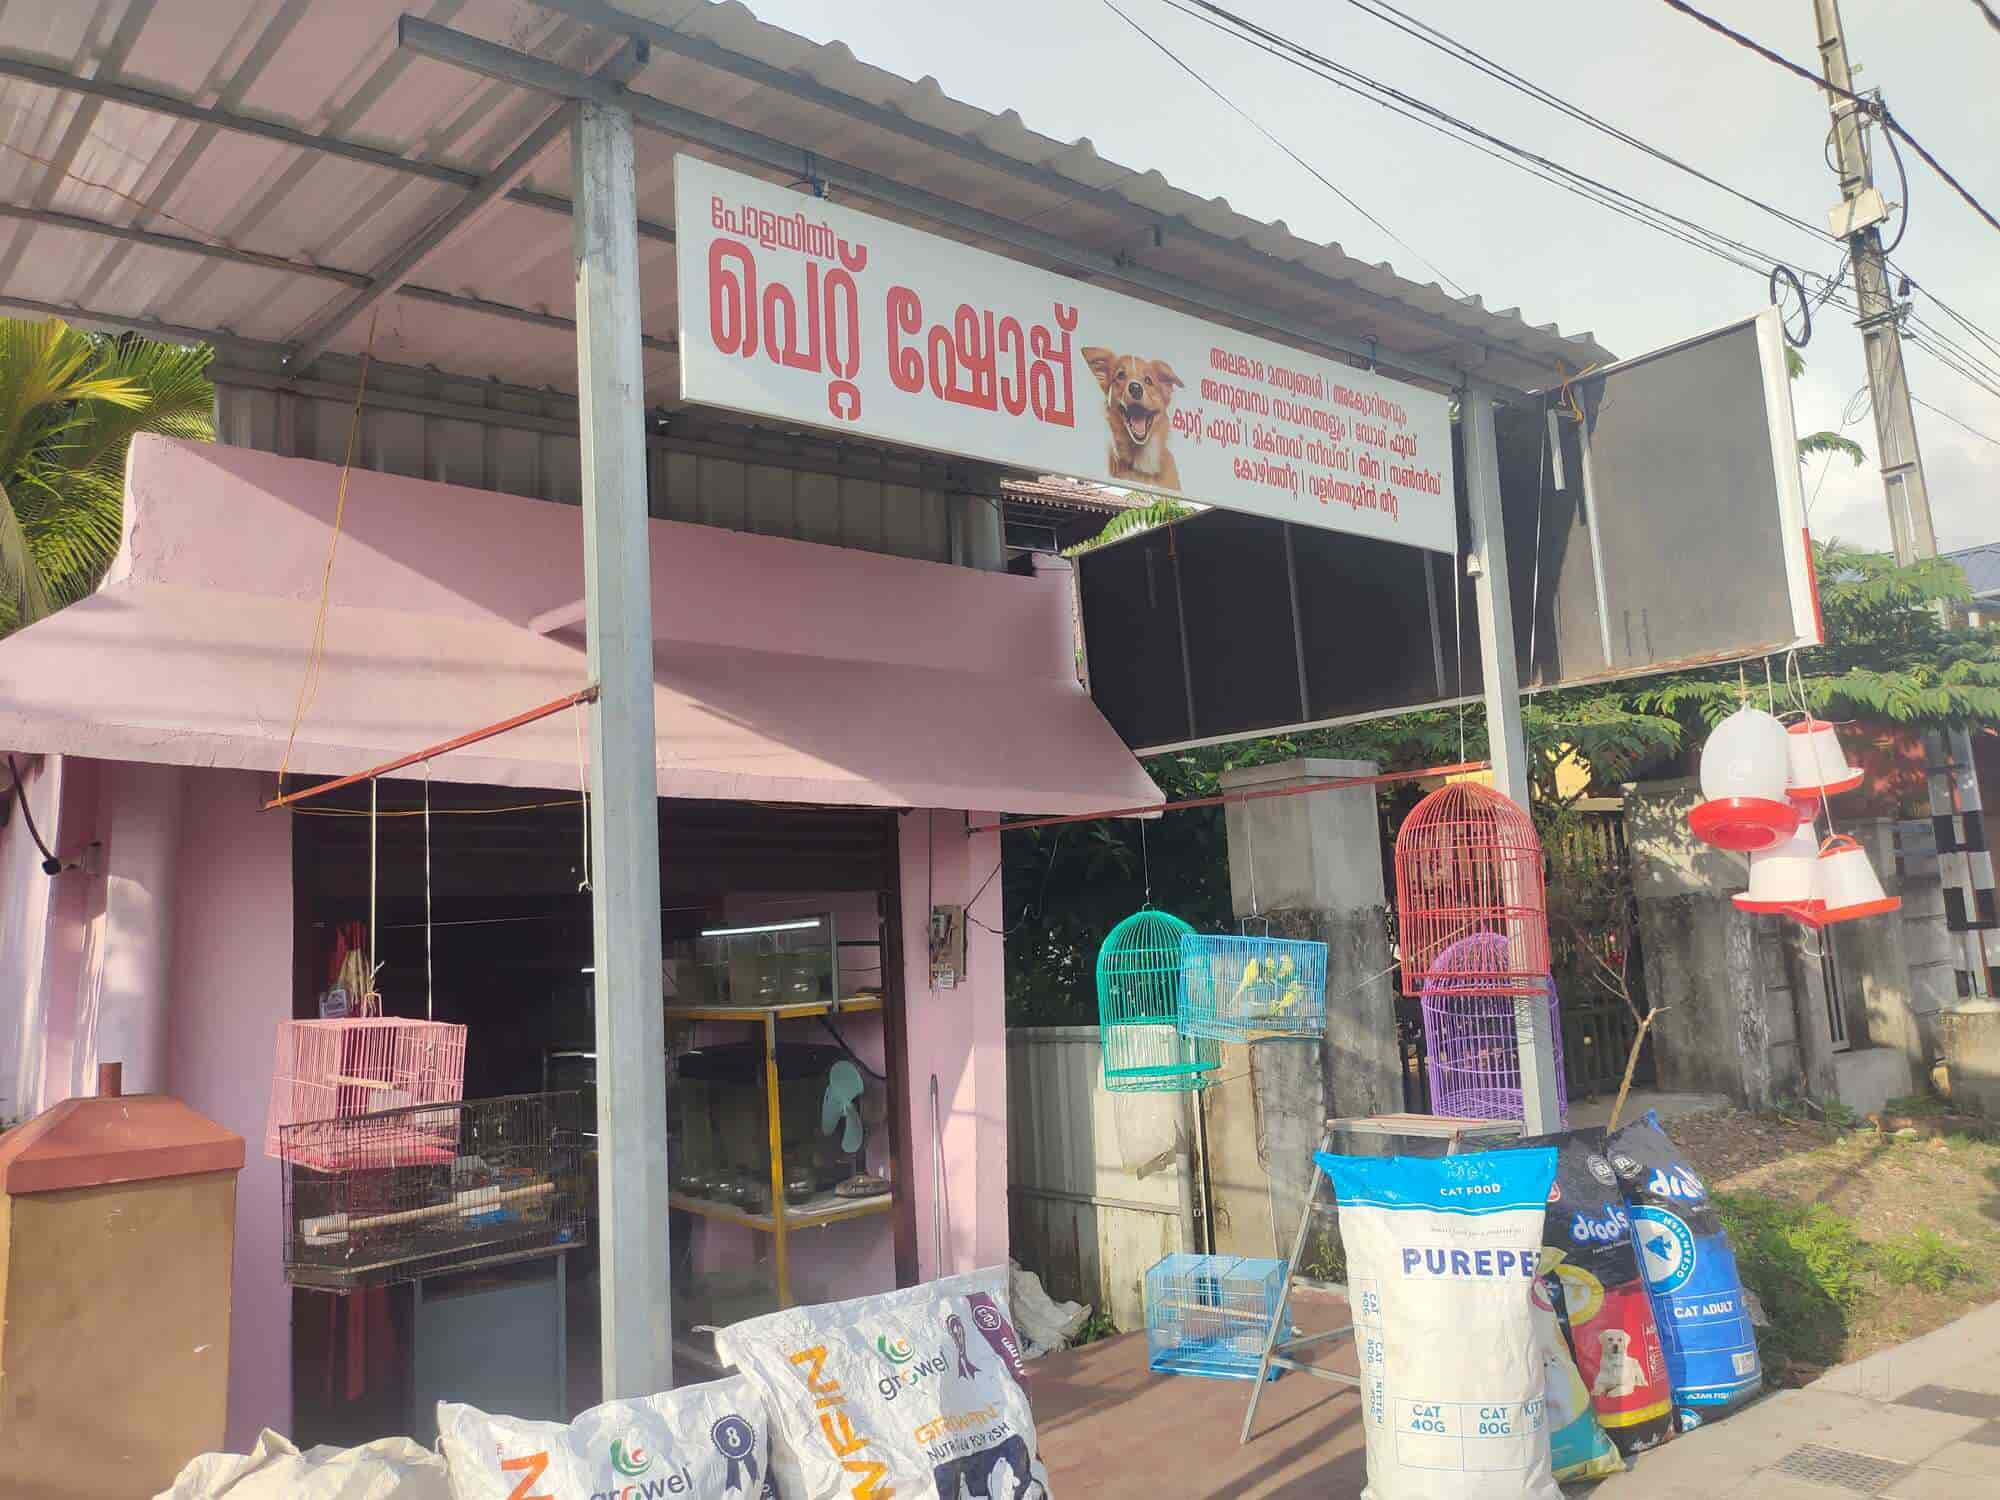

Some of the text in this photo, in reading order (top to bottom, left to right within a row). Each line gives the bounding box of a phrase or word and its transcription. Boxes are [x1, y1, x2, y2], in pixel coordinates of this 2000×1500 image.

[707, 237, 1080, 429] പെറ്റ് ഷോപ്പ്
[1209, 346, 1264, 382] അലങ്കാര
[1440, 1183, 1502, 1196] CAT FOOD
[1573, 1205, 1631, 1241] drools
[1402, 1247, 1541, 1278] PUREPE
[1674, 1300, 1734, 1318] CAT ADULT
[879, 1350, 950, 1401] growel
[1412, 1404, 1441, 1418] CAT
[1480, 1407, 1507, 1420] CAT
[1411, 1419, 1446, 1433] 40G
[1479, 1422, 1511, 1435] 80G
[726, 1427, 739, 1448] 8
